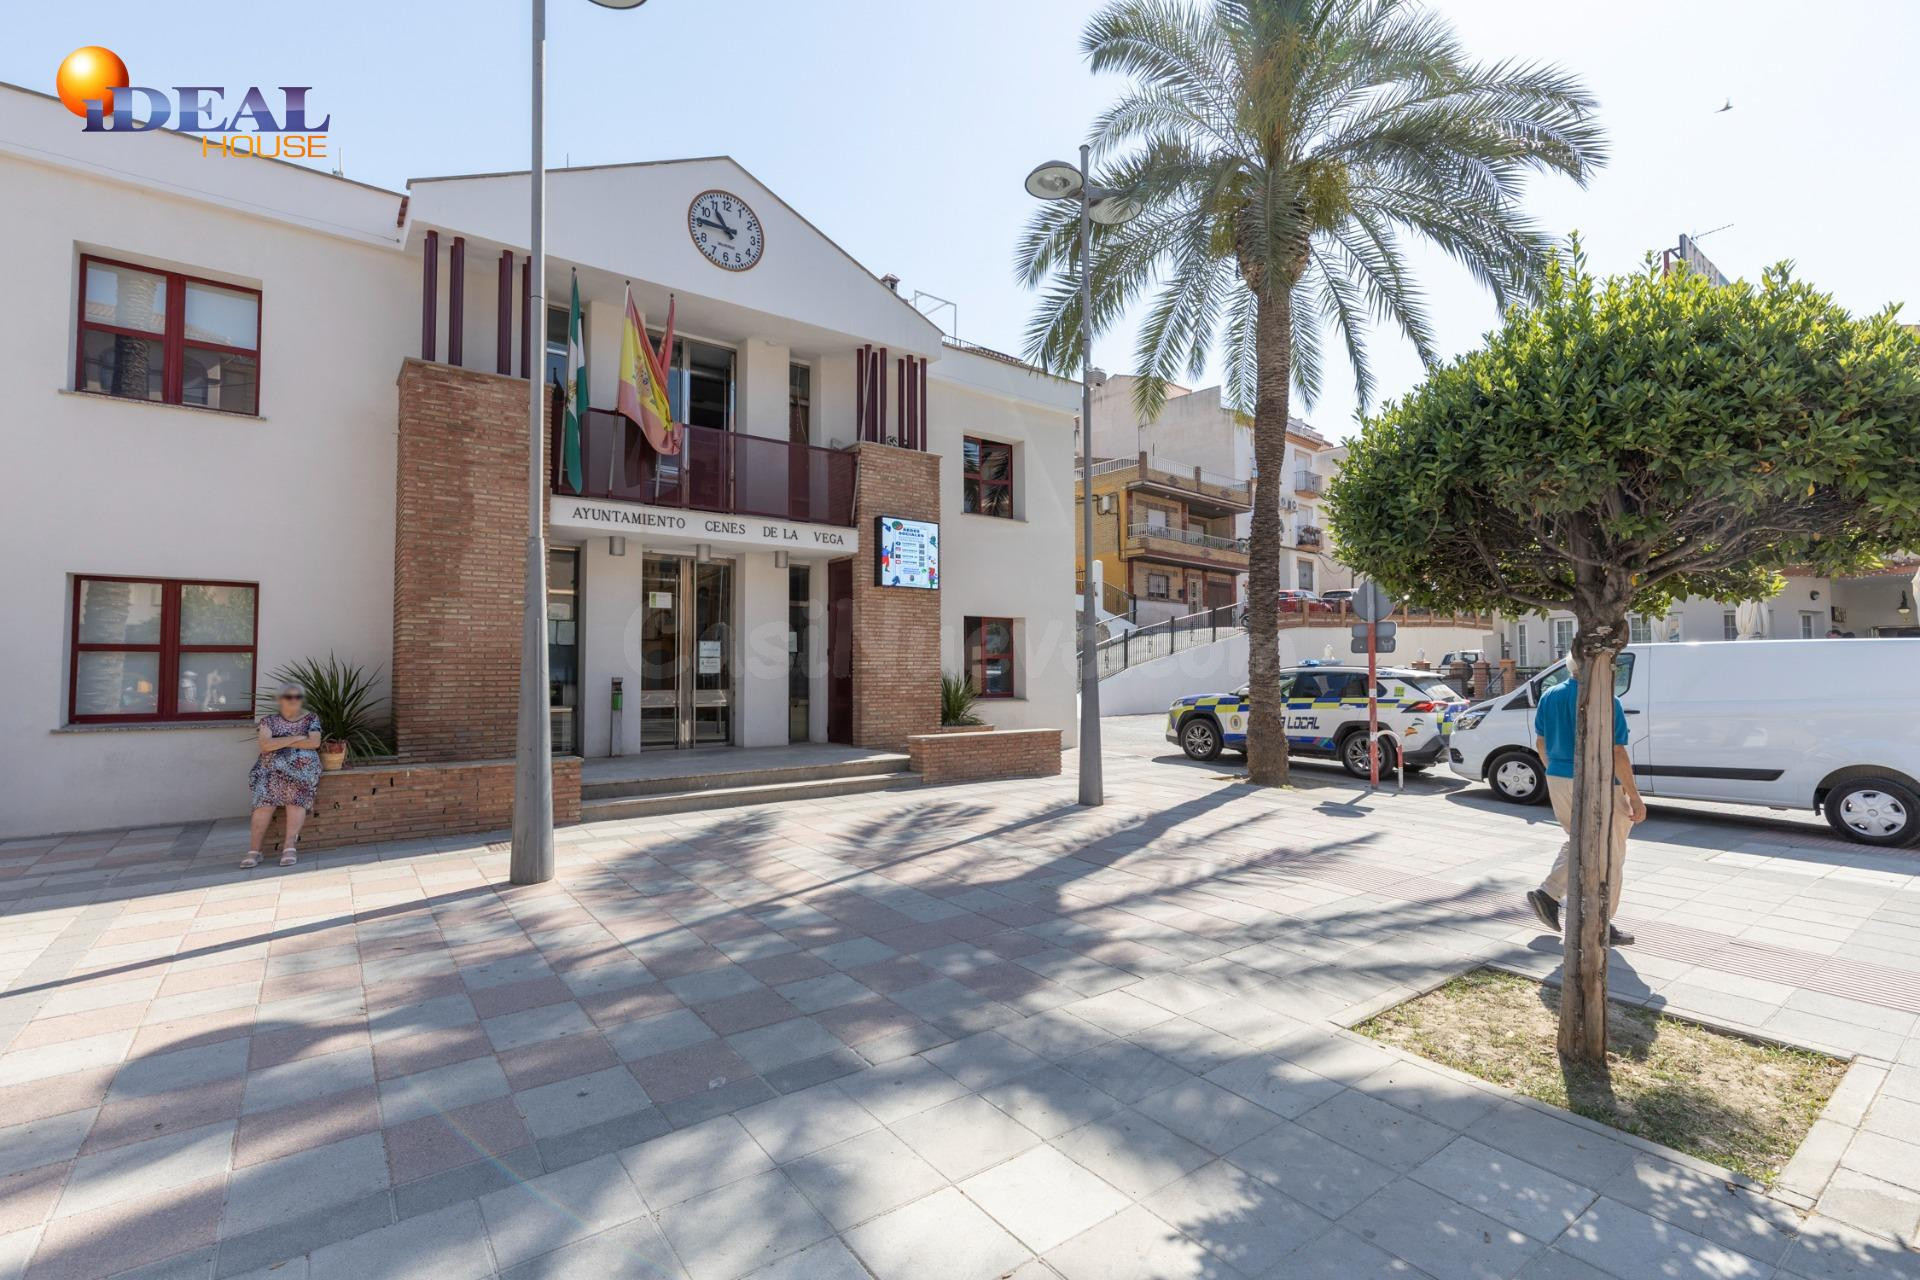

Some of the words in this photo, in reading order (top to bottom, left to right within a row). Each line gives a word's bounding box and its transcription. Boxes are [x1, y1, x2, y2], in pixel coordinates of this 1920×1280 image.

[722, 201, 732, 212] 12
[702, 207, 711, 218] 10
[738, 209, 742, 218] 1
[747, 221, 753, 232] 2
[701, 232, 707, 243] 8
[750, 236, 756, 246] 3
[711, 245, 717, 255] 7
[745, 248, 751, 258] 4
[723, 252, 729, 262] 6
[735, 253, 741, 263] 5
[572, 506, 686, 529] AYUNTAMIENTO
[705, 520, 746, 535] CENES
[762, 526, 779, 538] DE
[783, 527, 799, 540] LA
[813, 531, 844, 545] VEGA
[1287, 716, 1320, 729] LOCAL
